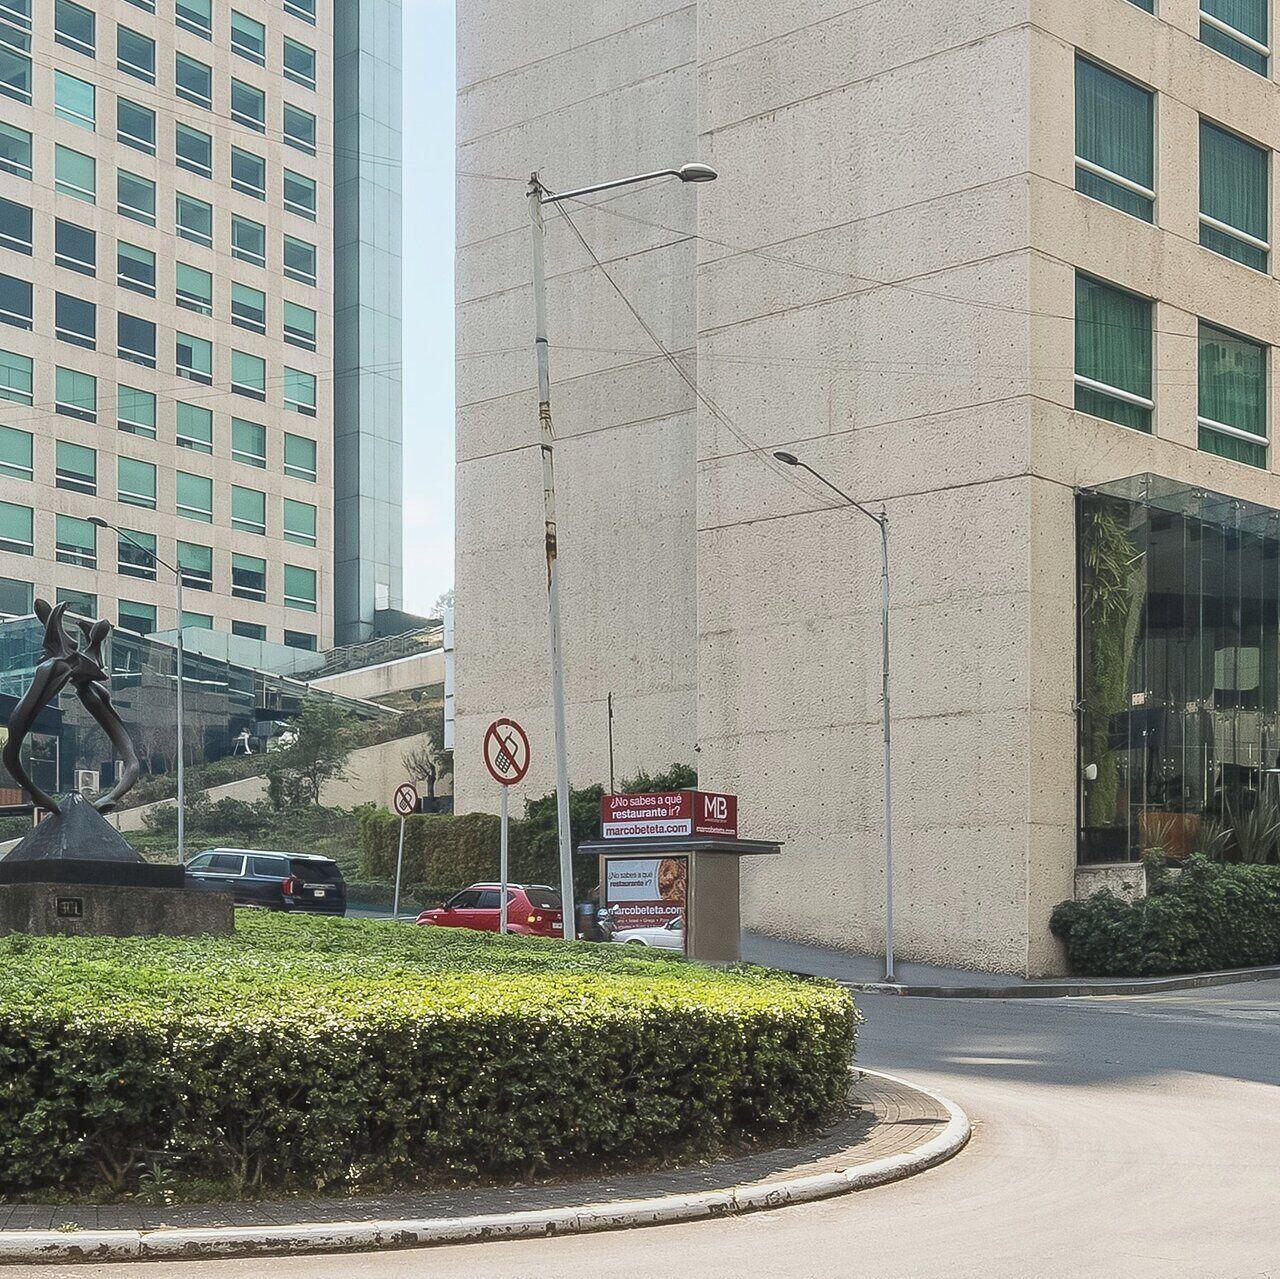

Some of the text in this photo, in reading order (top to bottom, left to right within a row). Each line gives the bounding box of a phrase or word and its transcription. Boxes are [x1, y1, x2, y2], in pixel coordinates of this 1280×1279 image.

[610, 793, 682, 809] ¿No sabes a qué
[704, 795, 727, 819] MB
[612, 805, 680, 820] restaurante ir?
[606, 823, 688, 837] marcobeteta.com
